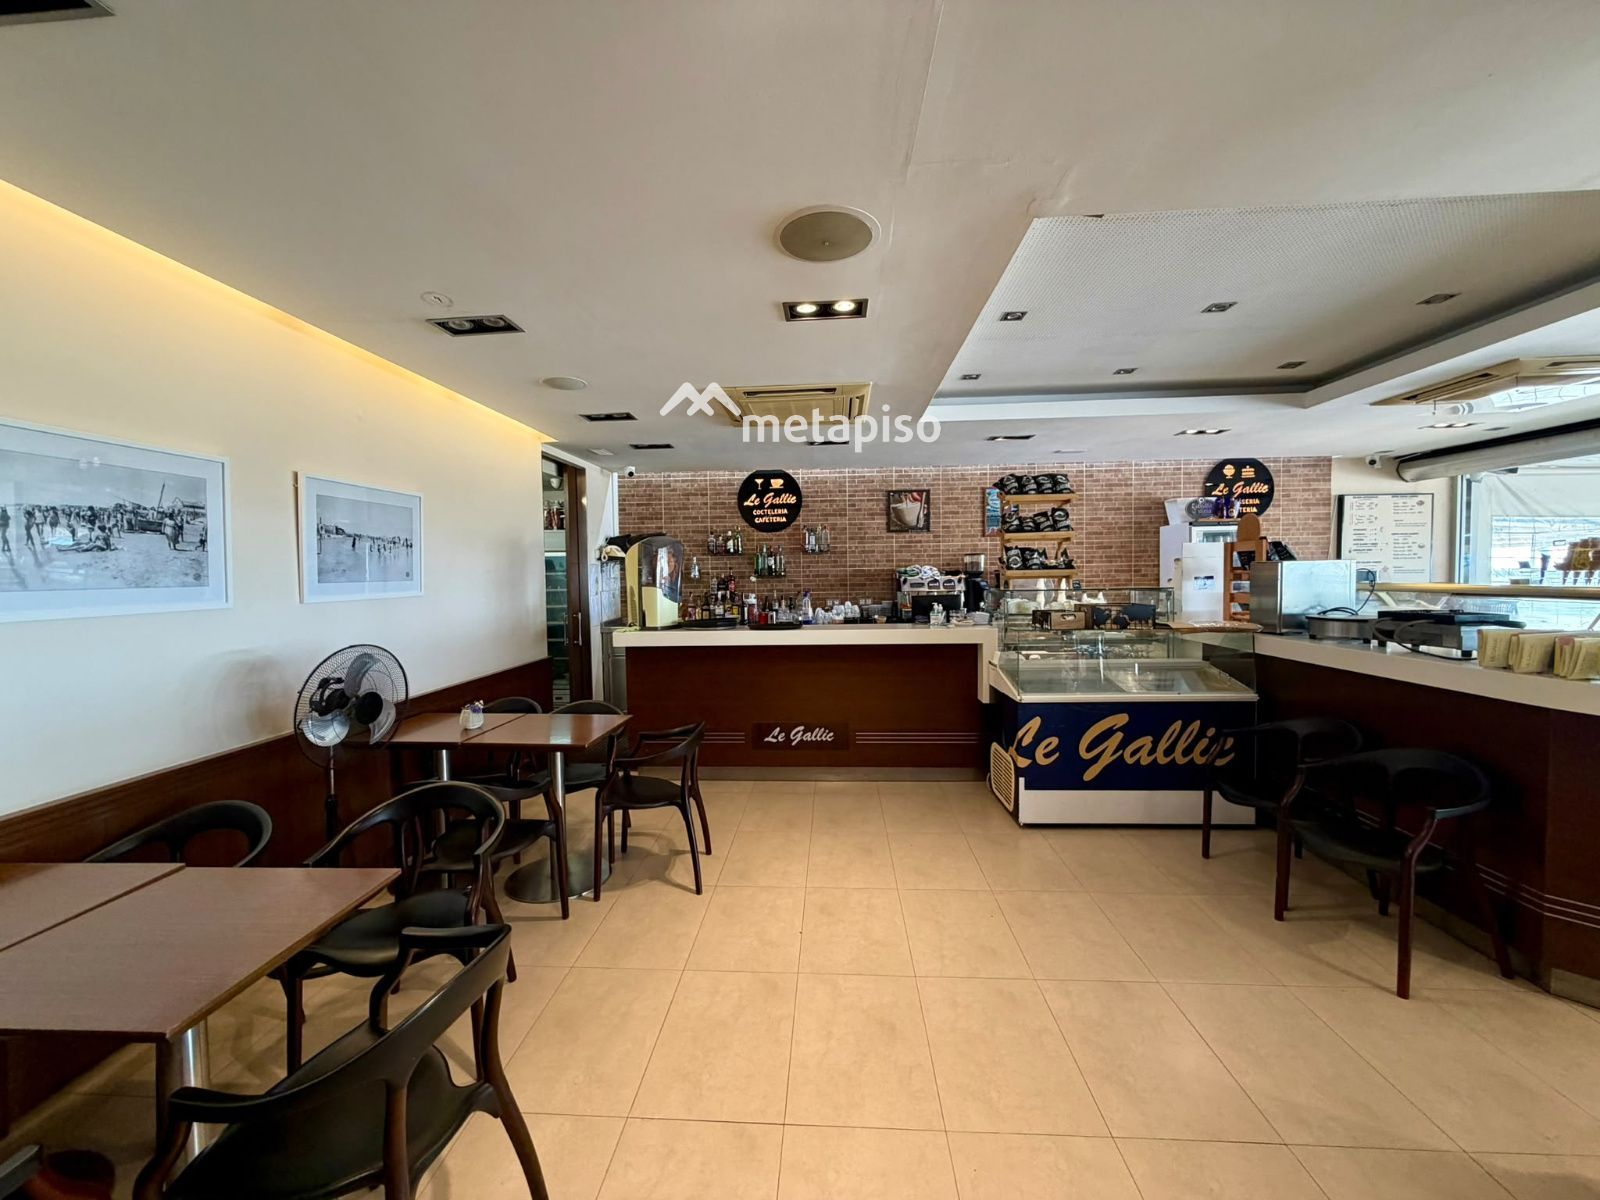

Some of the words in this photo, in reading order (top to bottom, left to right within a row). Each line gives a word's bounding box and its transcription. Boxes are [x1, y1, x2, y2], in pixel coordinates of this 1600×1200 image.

[743, 493, 760, 506] Le
[763, 492, 797, 508] Gallic
[1211, 483, 1229, 496] Le
[1232, 481, 1269, 501] Gallic
[752, 508, 788, 516] COCTELERIA
[763, 726, 786, 743] Le
[789, 725, 835, 746] Gallic
[1009, 716, 1060, 769] Le
